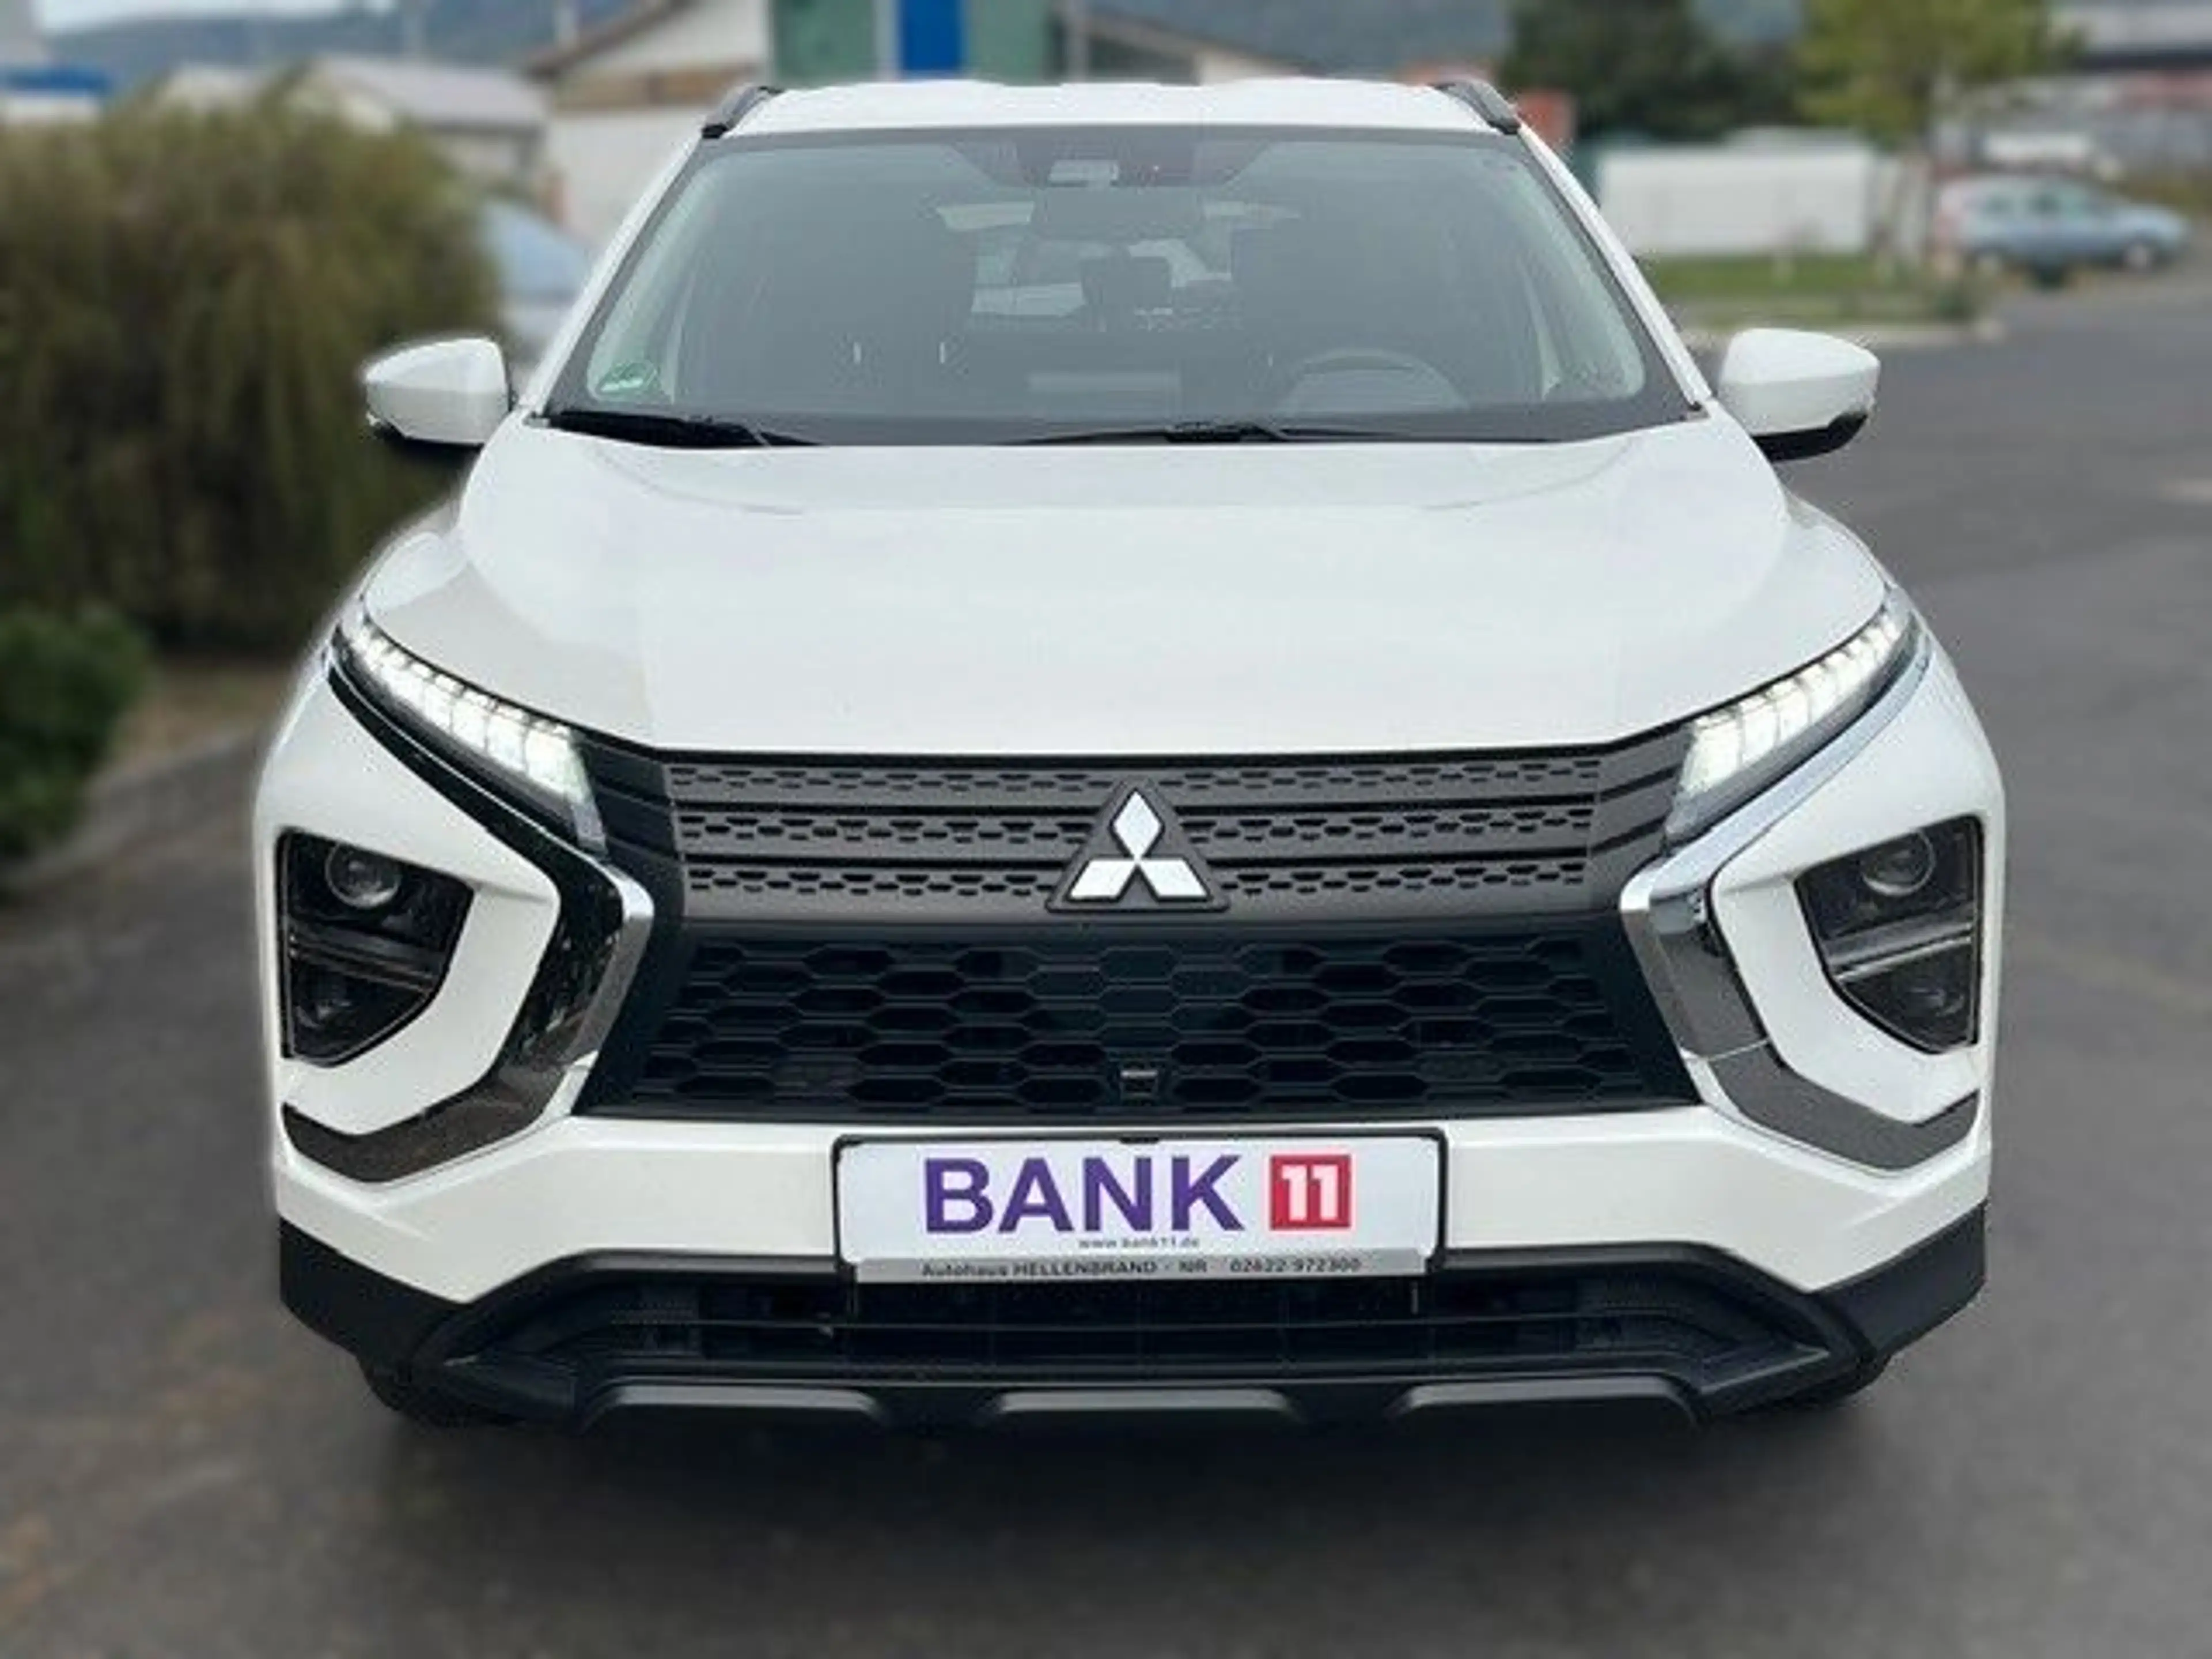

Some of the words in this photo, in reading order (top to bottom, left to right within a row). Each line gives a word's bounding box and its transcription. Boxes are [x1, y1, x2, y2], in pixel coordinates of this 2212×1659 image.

[923, 1155, 1245, 1233] BANK
[1280, 1164, 1339, 1222] 11
[921, 1261, 1007, 1277] Autohaus
[1013, 1259, 1157, 1276] HELLENBRAND
[1179, 1258, 1207, 1272] NR
